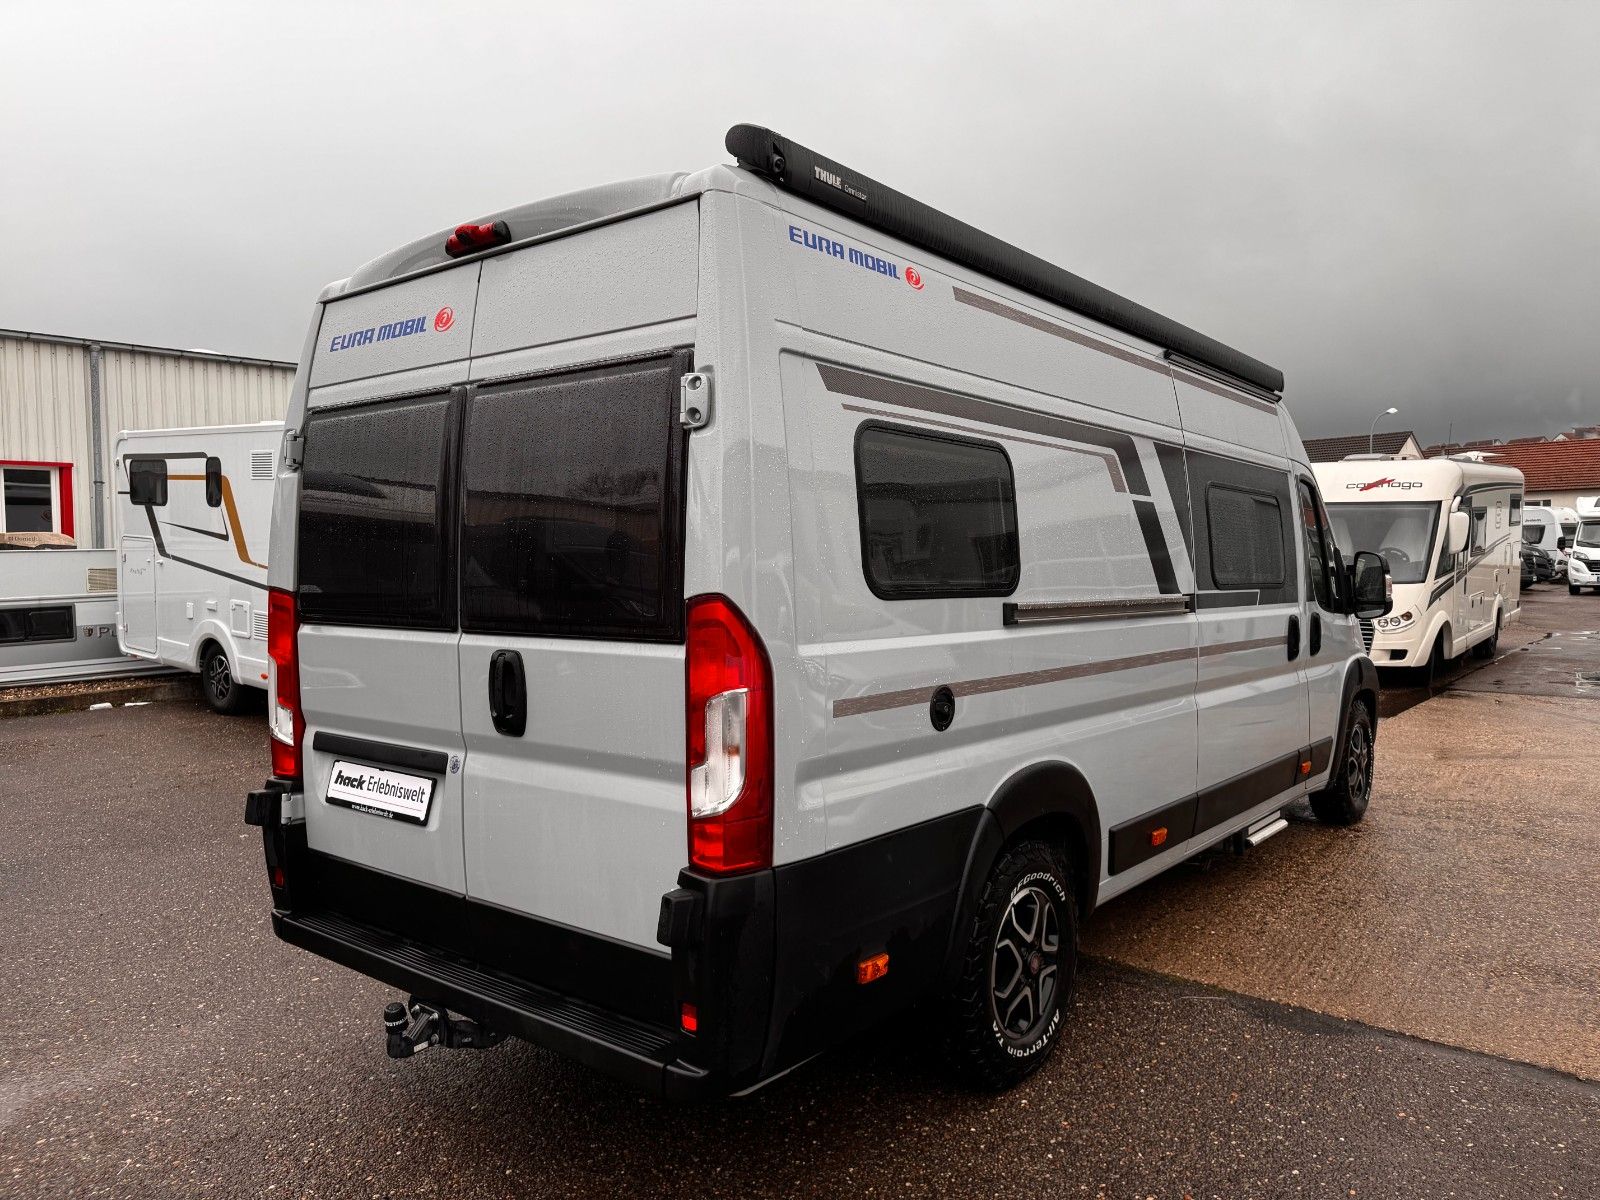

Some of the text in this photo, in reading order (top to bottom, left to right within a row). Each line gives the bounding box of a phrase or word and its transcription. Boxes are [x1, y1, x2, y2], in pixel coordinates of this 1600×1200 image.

[814, 165, 842, 189] THULE
[788, 224, 900, 280] EURA MOBIL
[329, 315, 427, 353] EURA MOBIL
[1345, 478, 1423, 490] cahago
[333, 769, 426, 804] hack Erlebniswelt
[1007, 1008, 1060, 1058] All-Terrain
